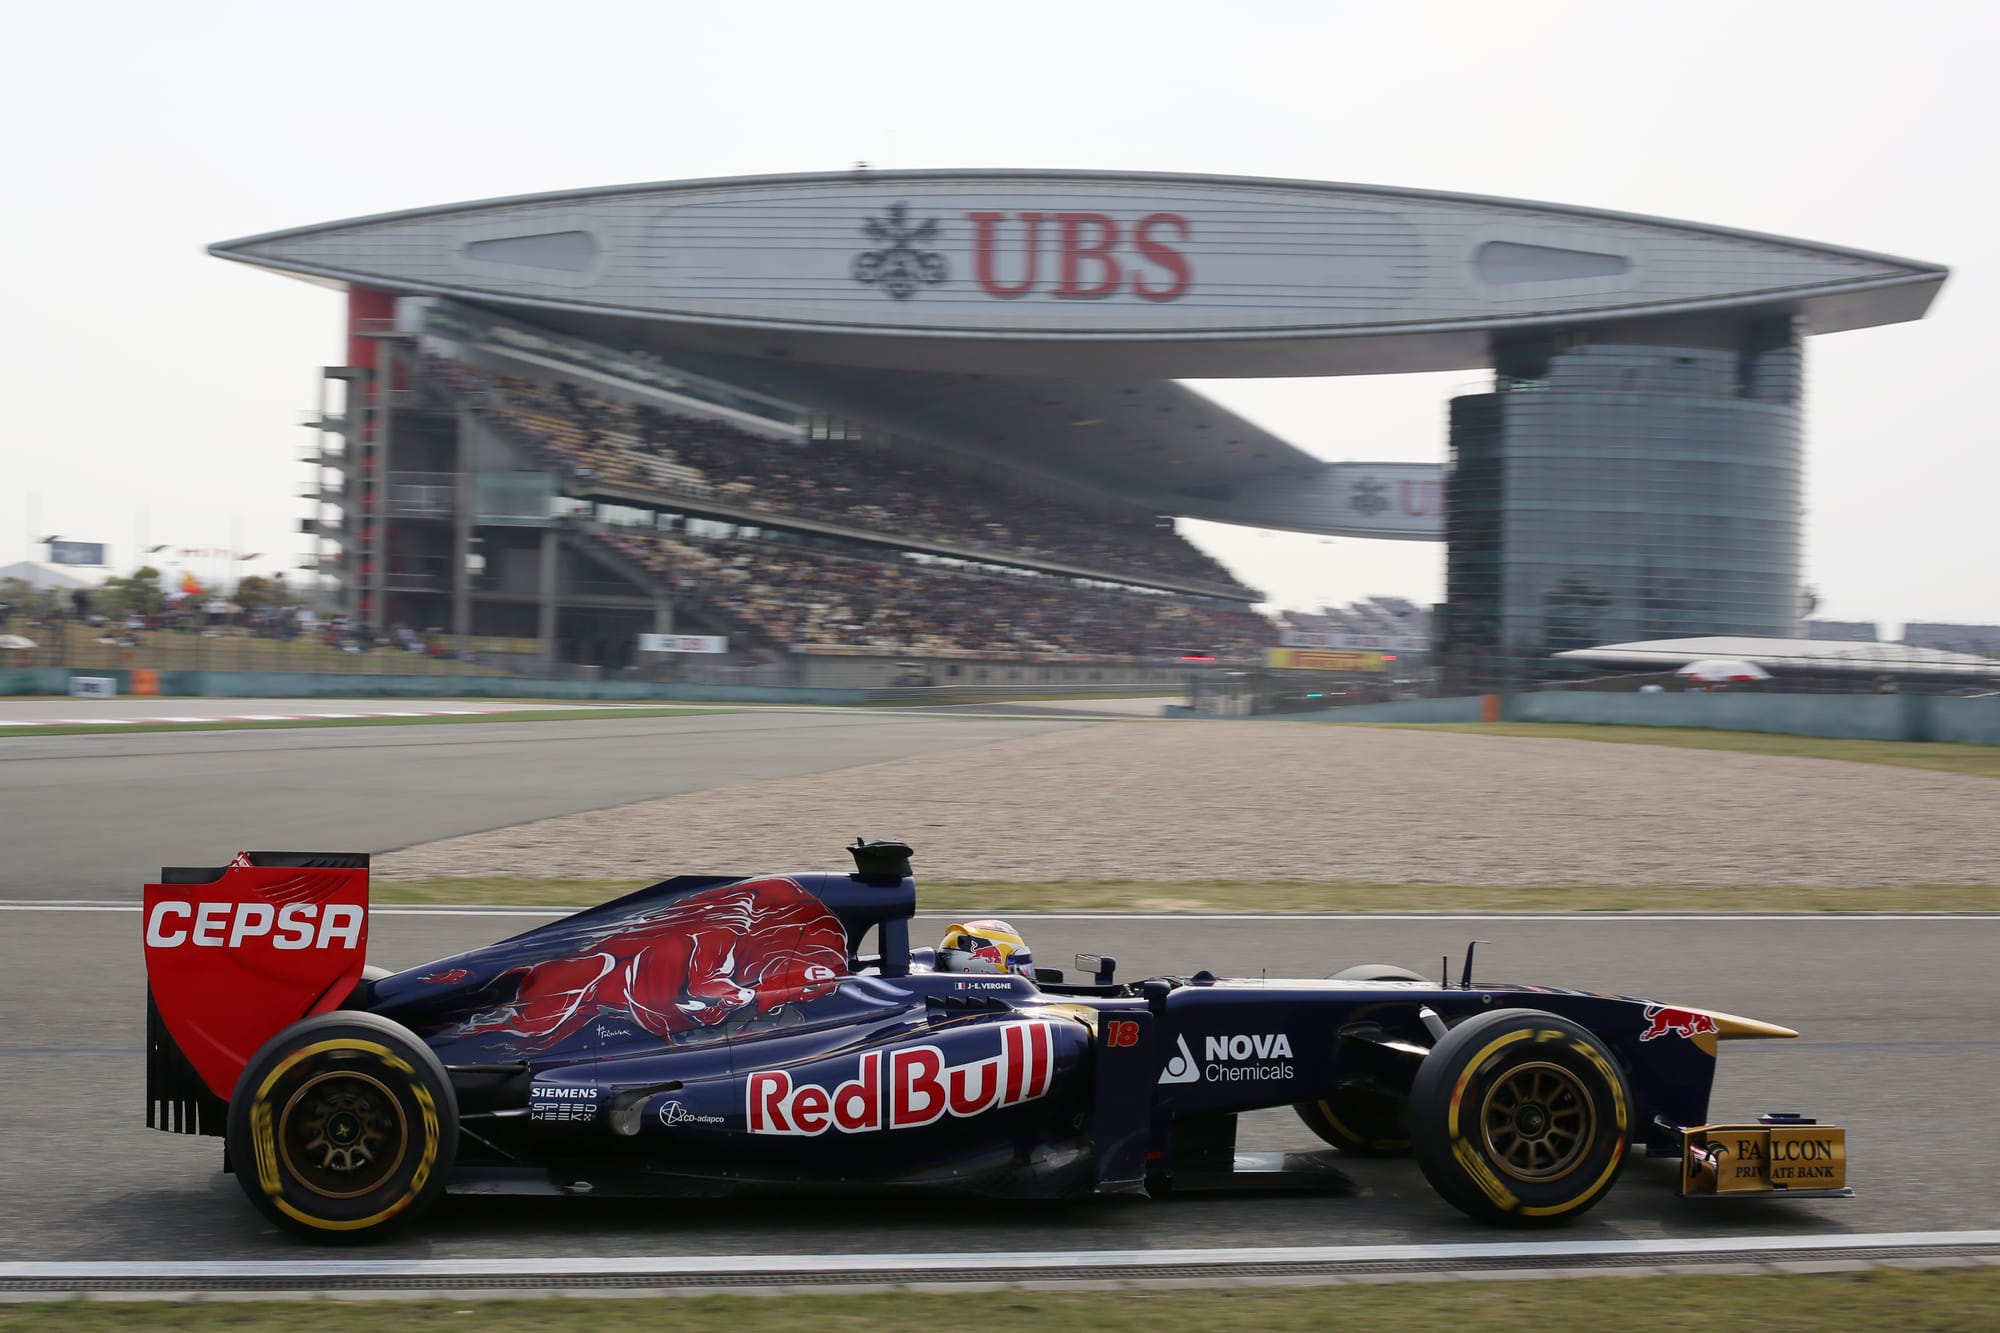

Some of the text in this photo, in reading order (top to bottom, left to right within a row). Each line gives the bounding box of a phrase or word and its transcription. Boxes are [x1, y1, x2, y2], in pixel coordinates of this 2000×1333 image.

[966, 211, 1193, 302] UBS
[145, 900, 364, 950] CEPSA
[982, 982, 1012, 990] VERGNE
[1106, 1020, 1140, 1048] 18
[1205, 1033, 1294, 1061] NOVA
[746, 1023, 1055, 1137] Red Bull
[1205, 1062, 1294, 1082] Chemicals
[531, 1087, 598, 1098] SIEMENS
[531, 1103, 598, 1112] SPEED
[531, 1112, 583, 1121] WEEK
[1736, 1140, 1833, 1161] FALCON
[1735, 1166, 1835, 1179] PRIVATE BANK
